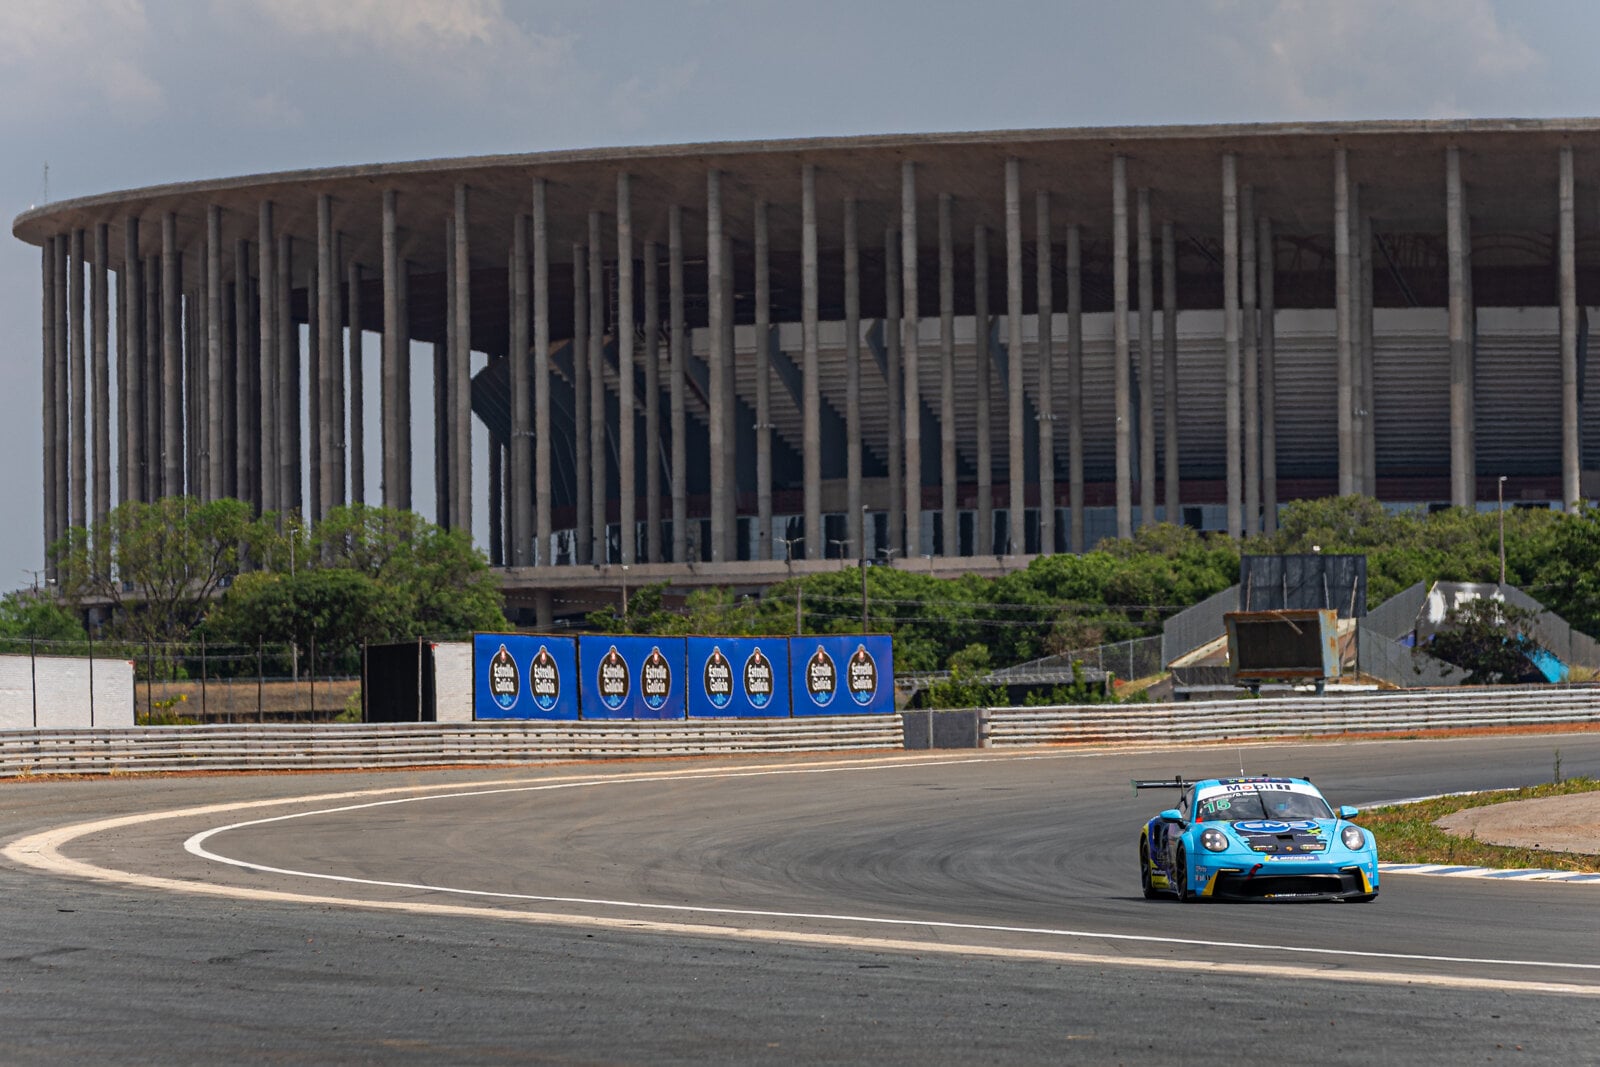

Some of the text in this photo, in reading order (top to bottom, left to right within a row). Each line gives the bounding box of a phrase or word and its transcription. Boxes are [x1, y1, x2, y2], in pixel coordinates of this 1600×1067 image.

[494, 664, 515, 677] Estrella
[534, 664, 556, 678] Estrella
[602, 664, 625, 678] Estrella
[645, 665, 667, 678] Estrella
[708, 664, 728, 678] Estrella
[748, 664, 769, 678] Estrella
[811, 663, 832, 676] Estrella
[852, 663, 873, 675] Estrella
[495, 678, 515, 692] Galicia
[535, 678, 556, 693] Galicia
[604, 678, 624, 692] Galicia
[646, 678, 666, 693] Galicia
[709, 678, 728, 692] Galicia
[749, 678, 769, 692] Galicia
[811, 676, 832, 690] Galicia
[853, 676, 873, 689] Galicia
[1226, 783, 1273, 791] Mobil
[1203, 799, 1231, 813] 15
